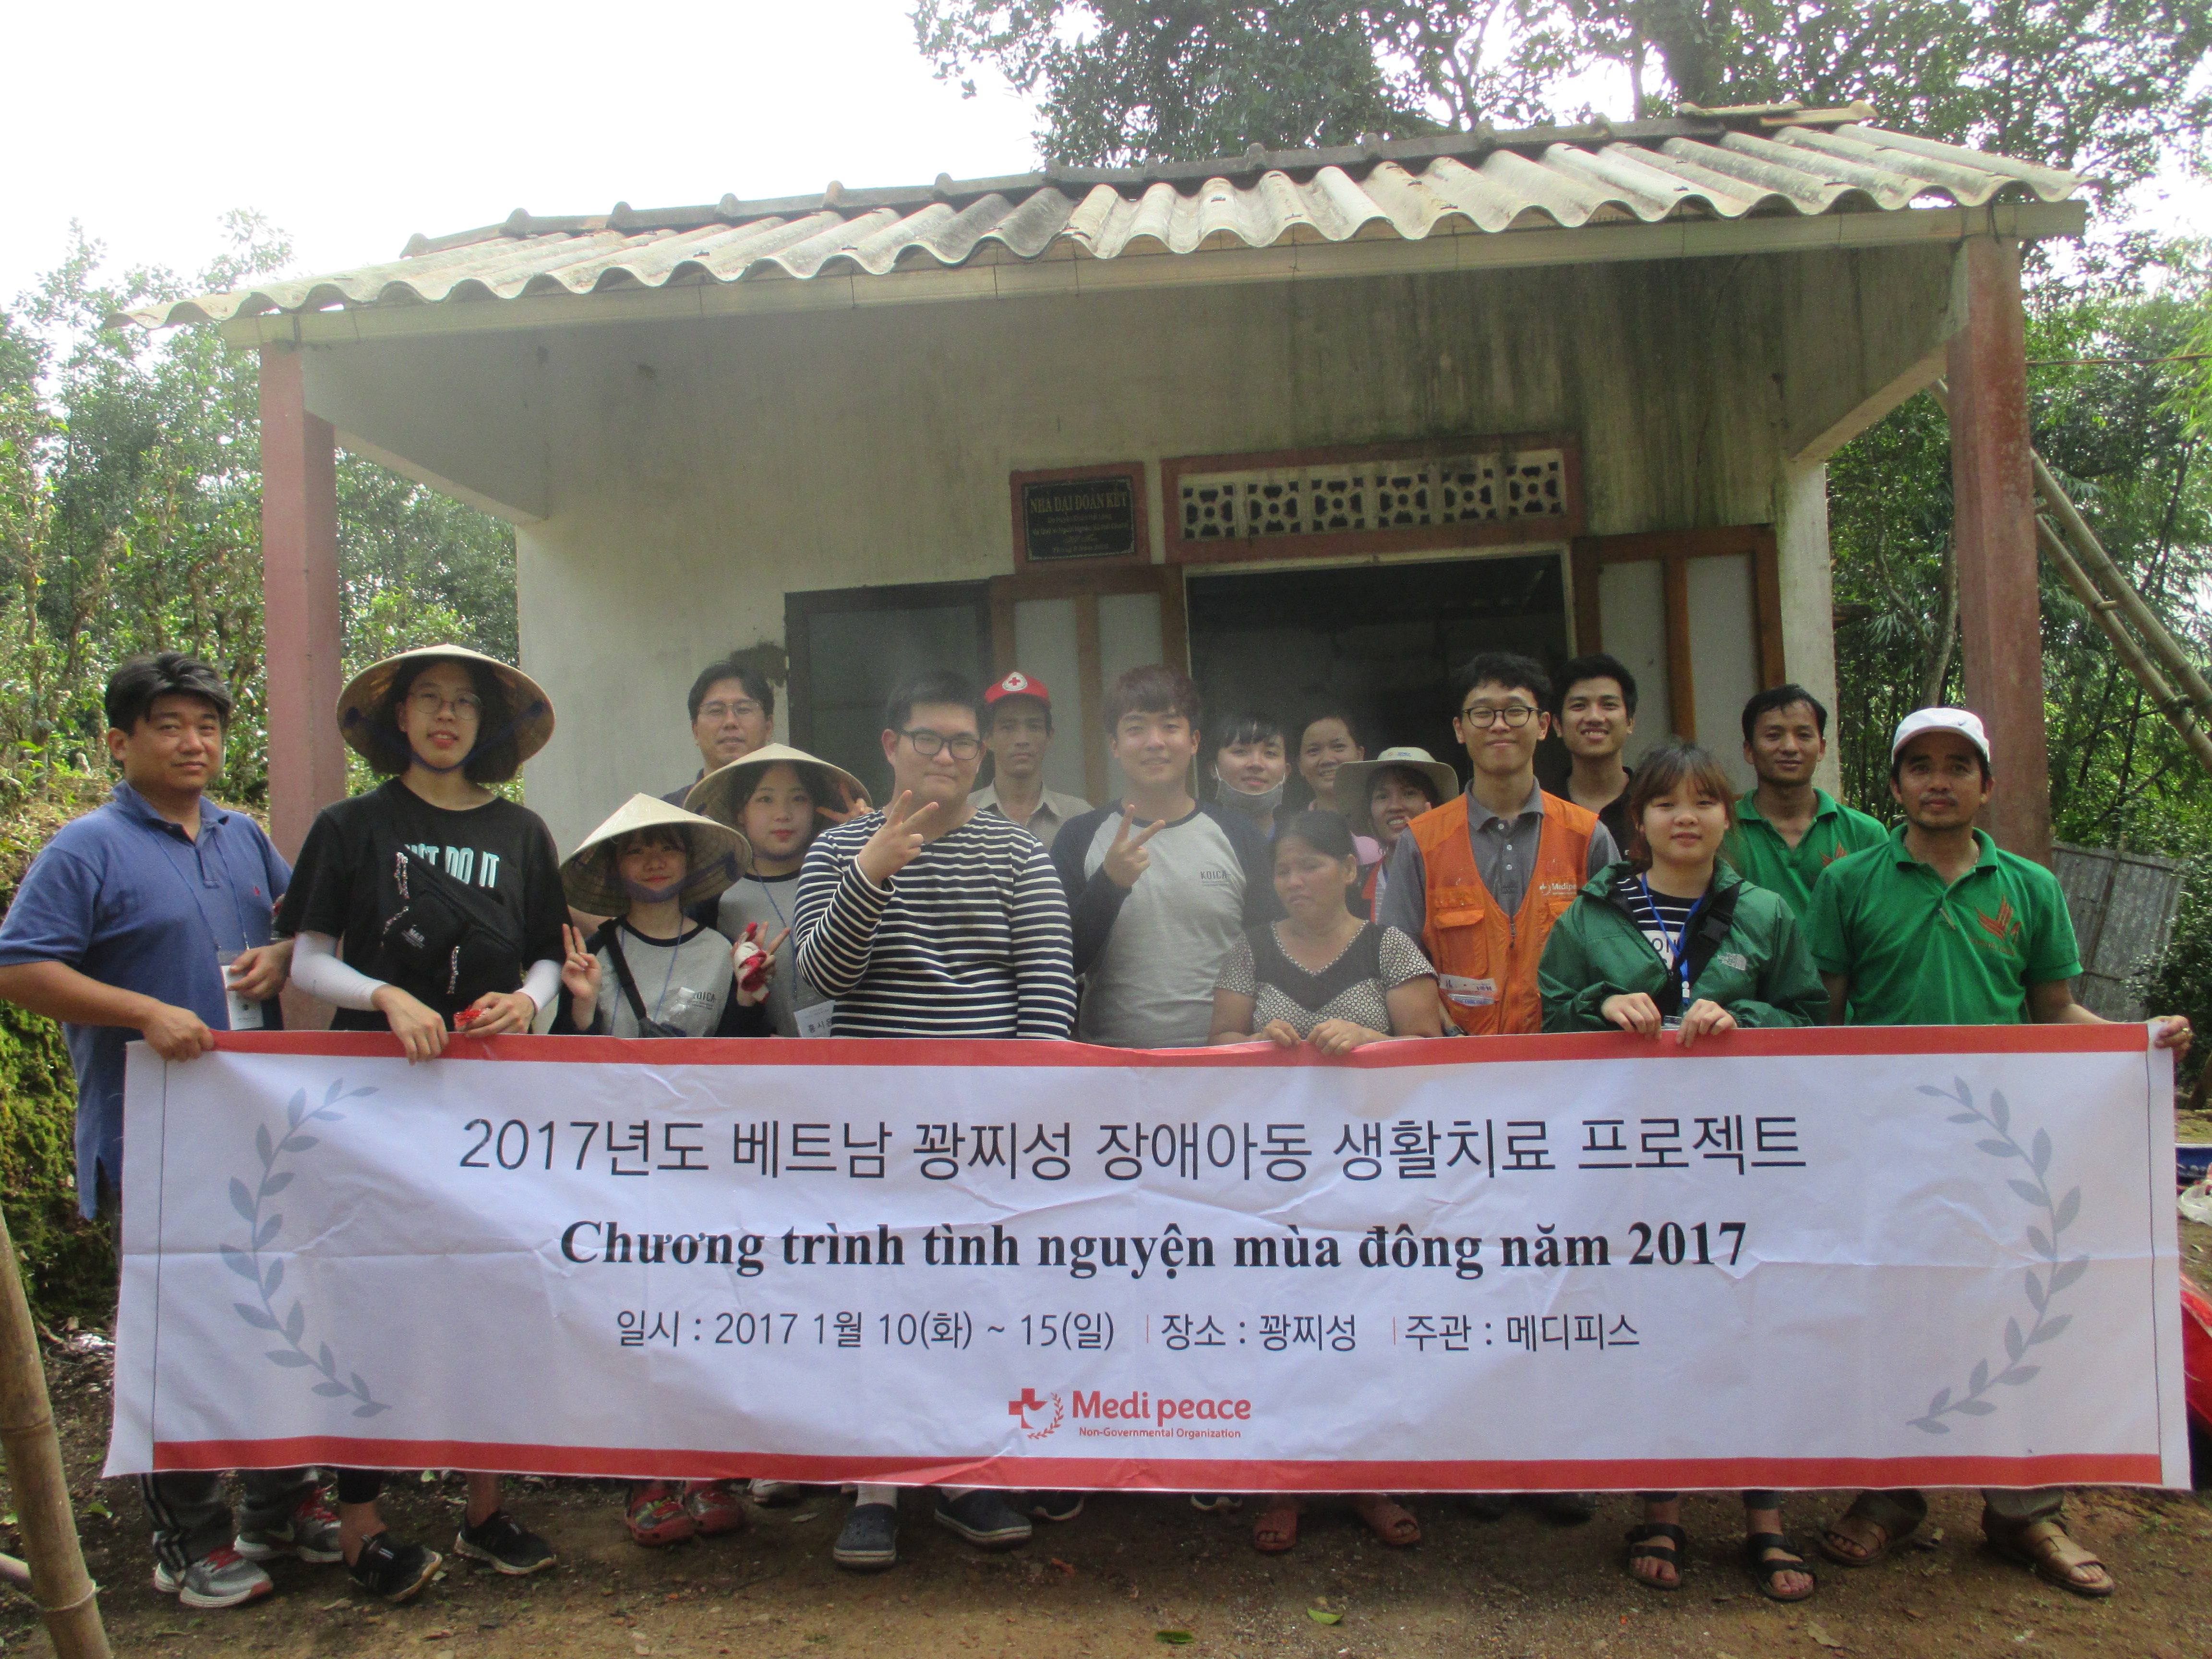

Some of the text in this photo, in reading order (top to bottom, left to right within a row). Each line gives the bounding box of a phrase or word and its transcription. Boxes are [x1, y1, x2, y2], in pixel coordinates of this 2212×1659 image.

[479, 851, 500, 888] IT
[1200, 870, 1227, 879] KOICA
[460, 1115, 1806, 1182] 2017년도 베트남 꽝찌성 장애아동 생활치료 프로젝트
[561, 1221, 1746, 1280] Chương trình tình nguyện mùa đông năm 2017
[617, 1310, 679, 1347] 일시
[715, 1312, 797, 1344] 2017
[815, 1311, 862, 1347] 1월
[880, 1311, 972, 1349] 10(화)
[1022, 1312, 1114, 1350] 15(일)
[1162, 1314, 1226, 1350] 장소
[1259, 1314, 1356, 1352] 꽝찌성
[1405, 1315, 1472, 1351] 주관
[1507, 1313, 1640, 1352] 메디피스
[1079, 1427, 1241, 1439] Non-Governmental Organization
